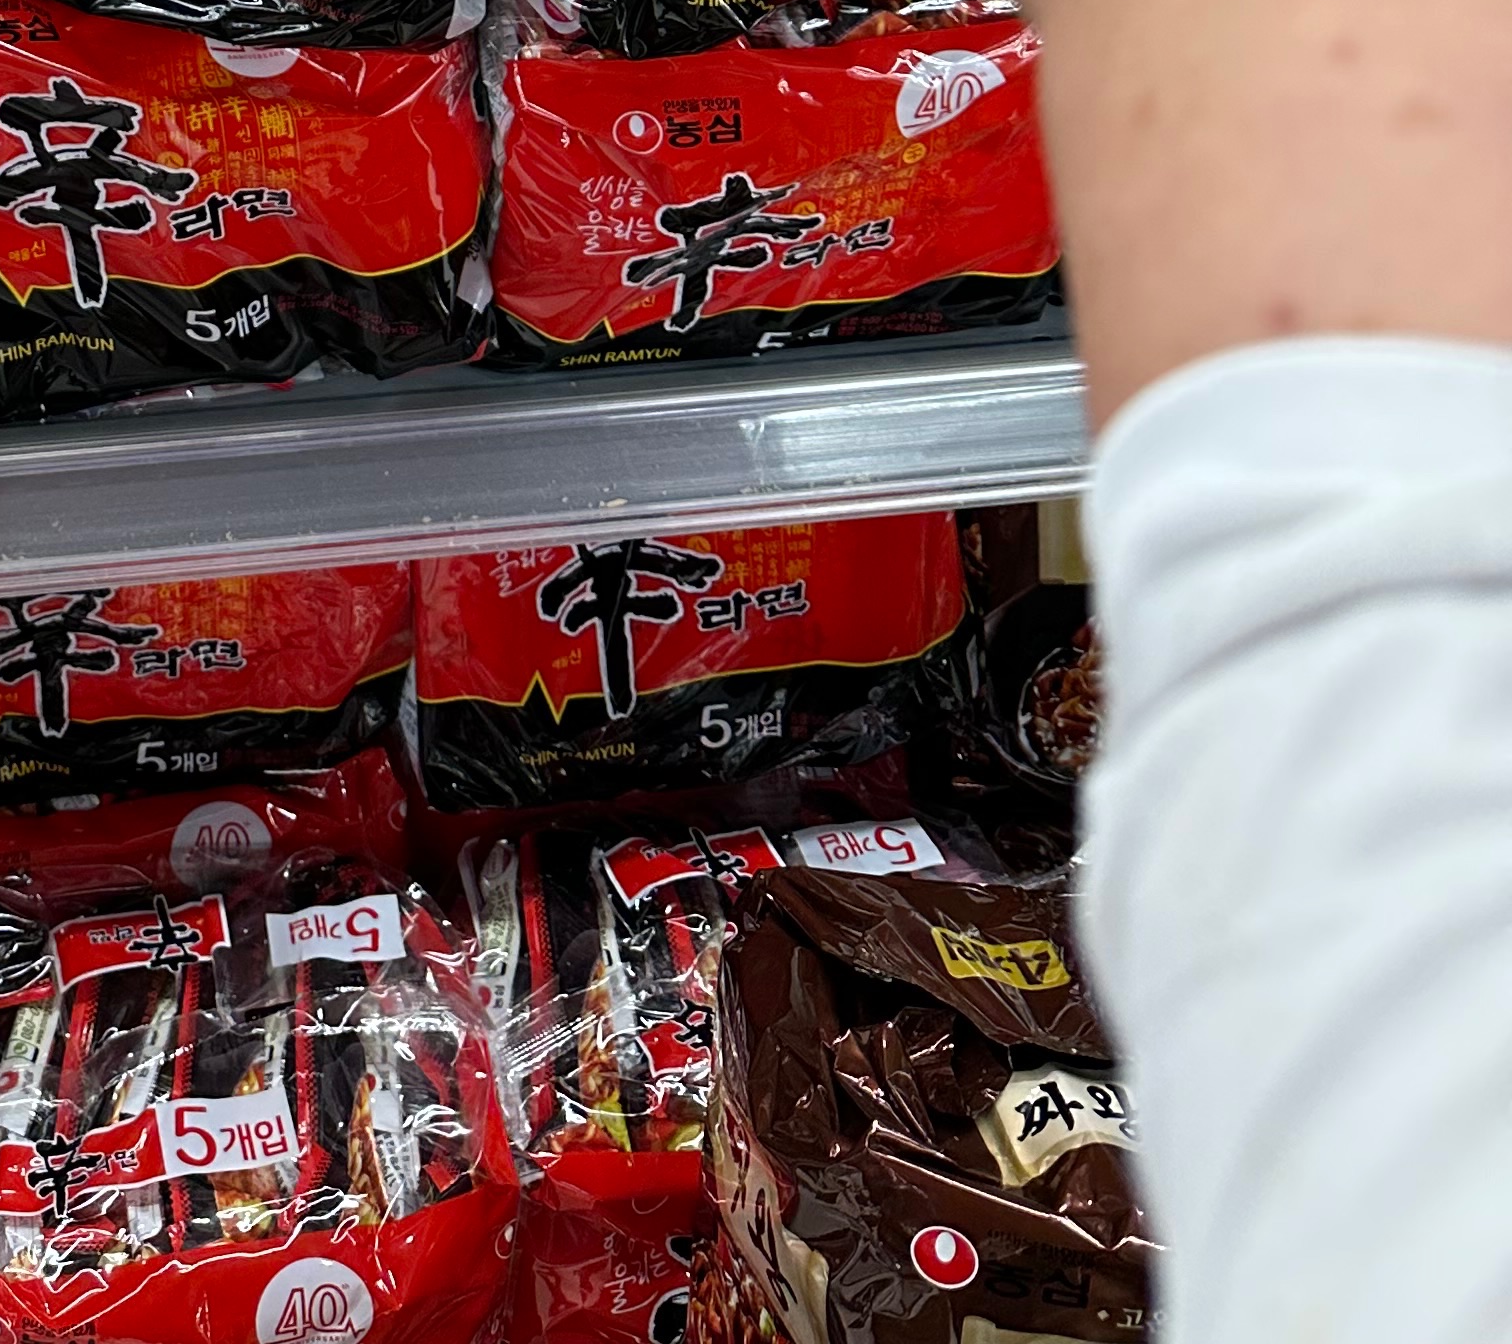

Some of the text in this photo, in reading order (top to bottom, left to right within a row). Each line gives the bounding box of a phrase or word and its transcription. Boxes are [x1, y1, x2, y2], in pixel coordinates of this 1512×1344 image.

[664, 114, 744, 148] 농심
[168, 189, 297, 242] 라면
[186, 295, 270, 343] 5개입
[34, 333, 115, 356] RAMYUN
[560, 346, 682, 368] SHIN RAMYUN
[696, 580, 811, 633] 라면
[132, 639, 247, 678] 라면
[699, 702, 783, 749] 5개입
[0, 760, 70, 786] RAMYUN
[136, 741, 219, 774] 5개입
[564, 741, 636, 763] RAMYUN
[287, 906, 381, 955] 5개입
[172, 1105, 291, 1168] 5개입
[27, 1134, 102, 1217] 辛
[275, 1284, 348, 1337] 40
